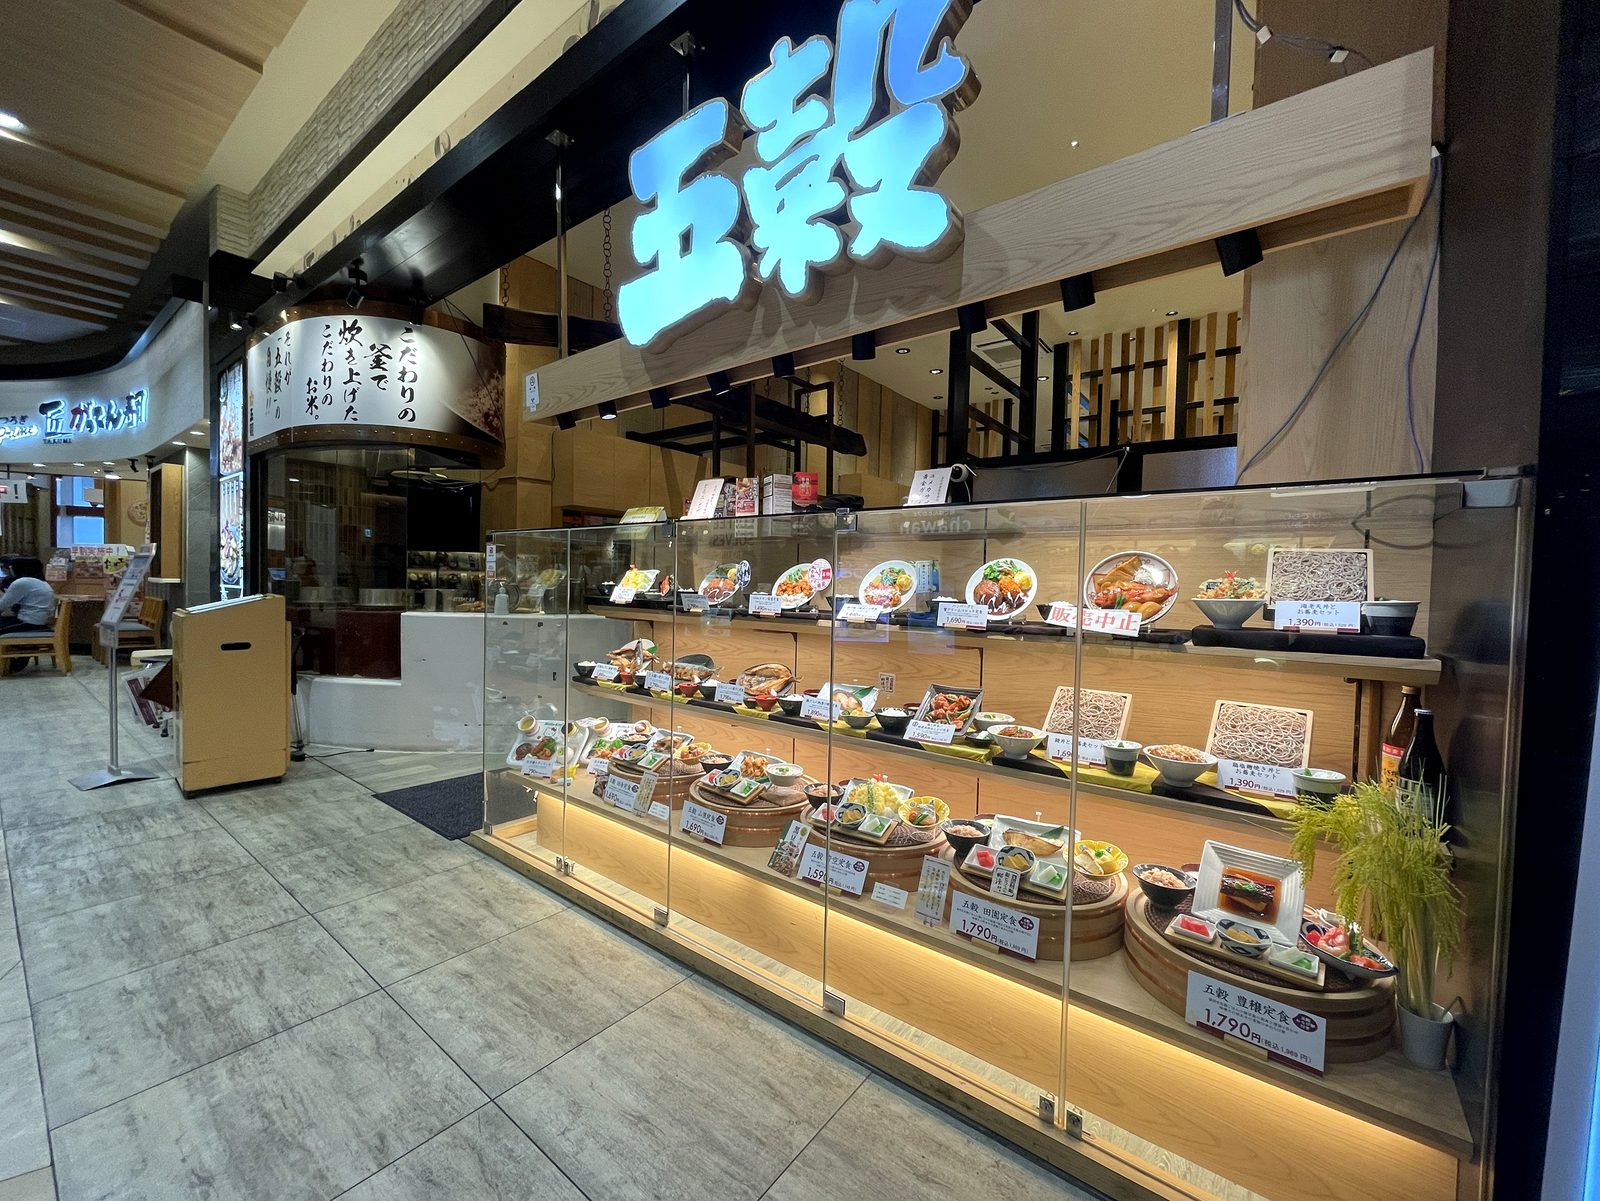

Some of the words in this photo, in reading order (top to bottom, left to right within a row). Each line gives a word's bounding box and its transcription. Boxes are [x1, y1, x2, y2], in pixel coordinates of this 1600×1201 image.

[321, 324, 334, 406] こだわりの
[338, 318, 364, 422] 炊き上げた
[363, 343, 393, 391] 釜で
[397, 326, 418, 423] こだわりの
[1051, 606, 1138, 631] 販売中止
[962, 900, 979, 914] 五穀
[983, 907, 1018, 926] 田園定食
[1202, 983, 1229, 1003] 五穀
[1237, 994, 1291, 1026] 豊穣定食
[1205, 1008, 1261, 1044] 1,790円
